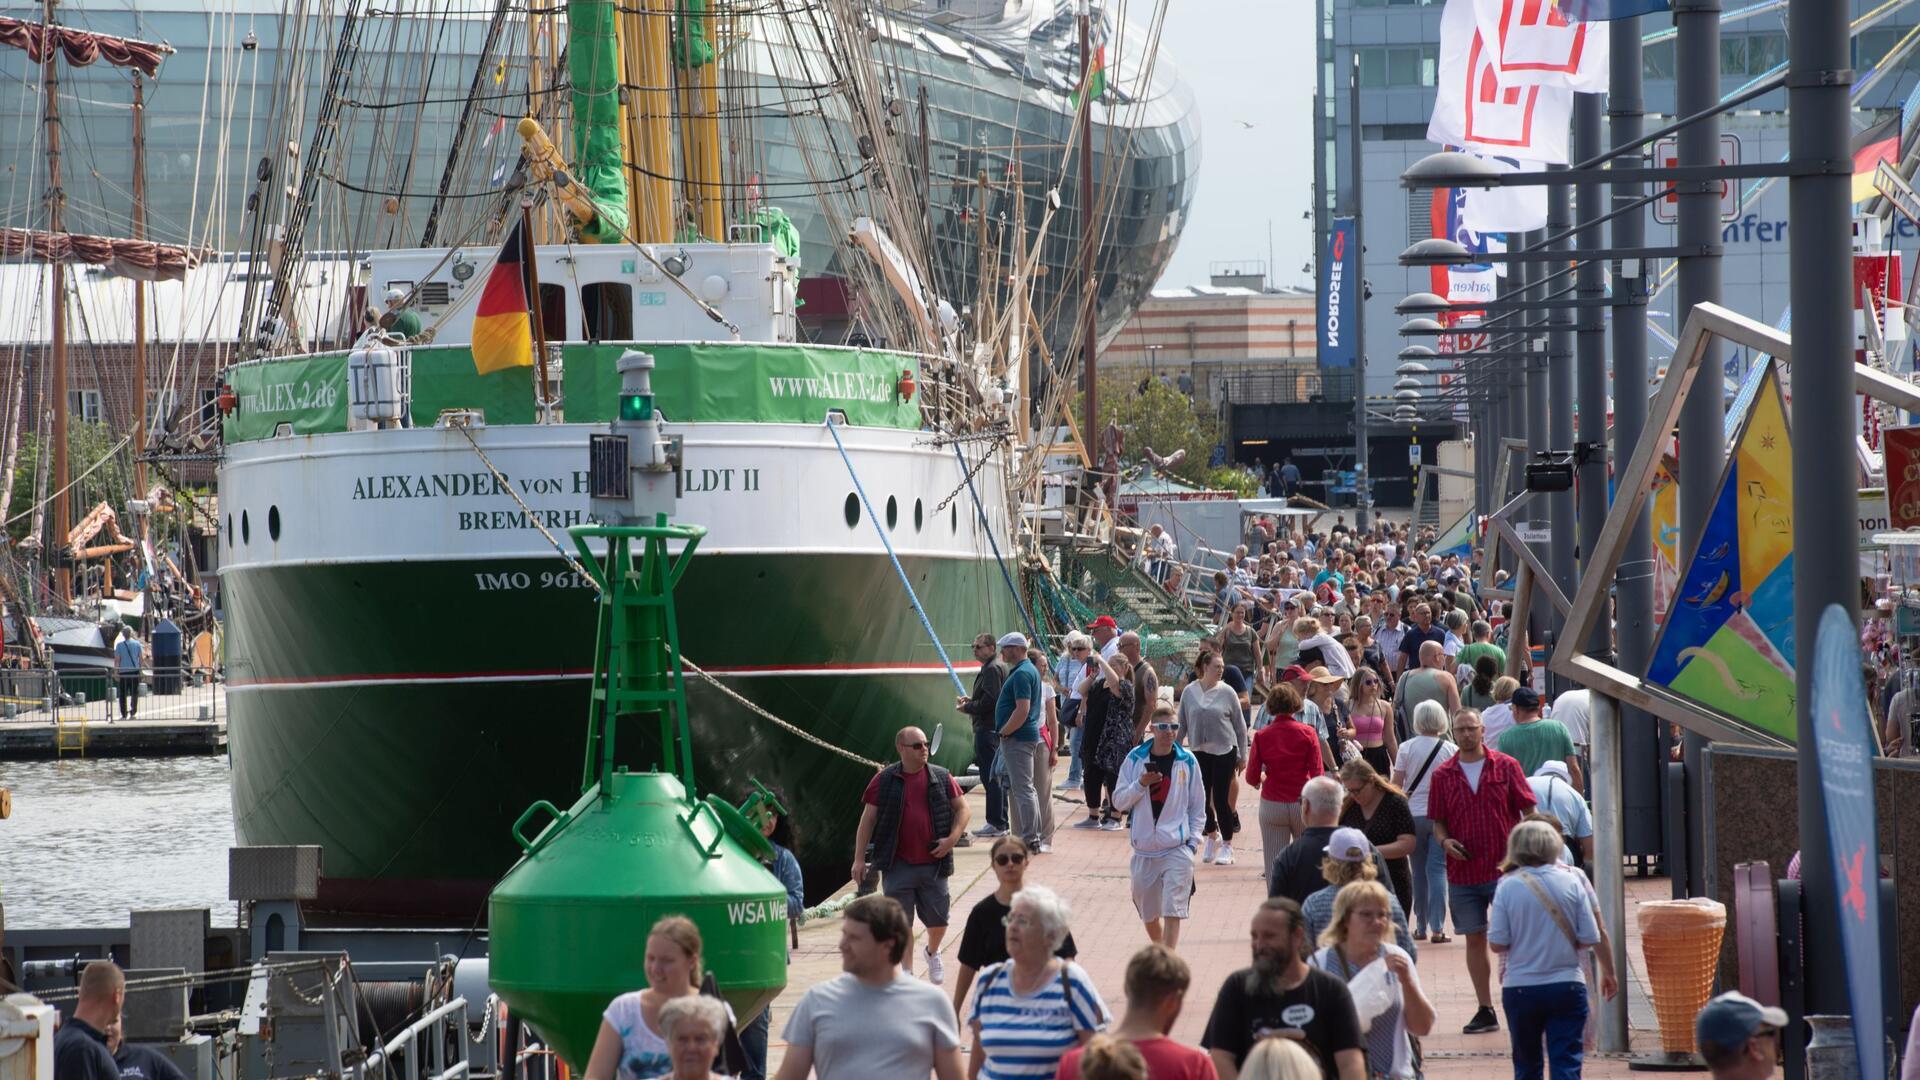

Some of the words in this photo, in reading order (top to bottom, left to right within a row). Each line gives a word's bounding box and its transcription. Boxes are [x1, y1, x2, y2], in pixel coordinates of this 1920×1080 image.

[769, 371, 892, 402] www.ALEX-2.de
[352, 472, 512, 500] ALEXANDER
[743, 469, 760, 491] II
[475, 572, 531, 591] IMO
[727, 902, 767, 926] WSA
